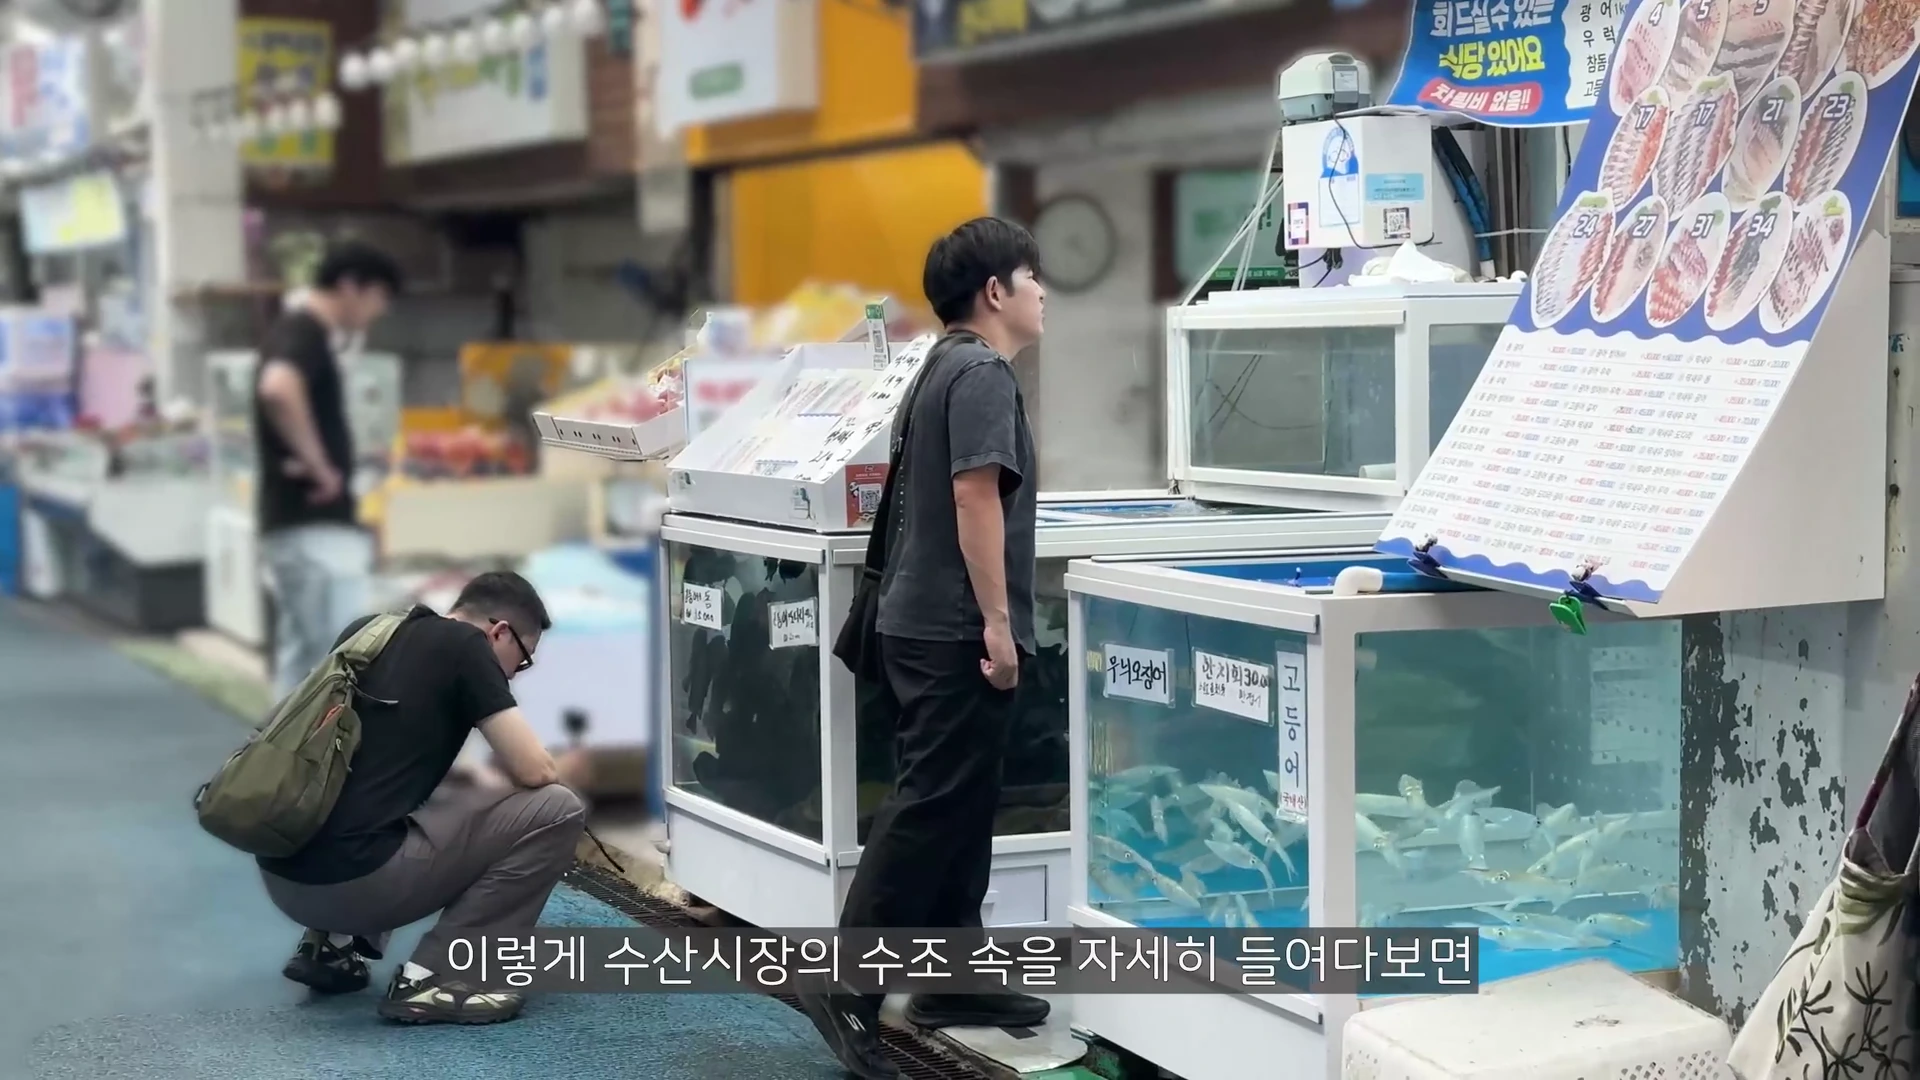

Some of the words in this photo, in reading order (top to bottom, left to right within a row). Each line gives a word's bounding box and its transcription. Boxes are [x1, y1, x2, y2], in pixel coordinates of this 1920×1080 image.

[1648, 2, 1664, 26] 4
[1439, 41, 1485, 80] 식당
[1487, 35, 1545, 77] 있어요
[1586, 53, 1607, 73] 참돔
[1488, 87, 1533, 111] 없음!!
[1762, 98, 1784, 122] 21
[1822, 94, 1850, 119] 23
[1634, 104, 1656, 129] 17
[1695, 103, 1717, 127] 17
[1573, 214, 1599, 238] 24
[1632, 214, 1657, 238] 27
[1691, 214, 1715, 238] 31
[1748, 214, 1776, 238] 34
[1107, 655, 1167, 694] 무늬오징어
[1283, 664, 1301, 788] 고등어
